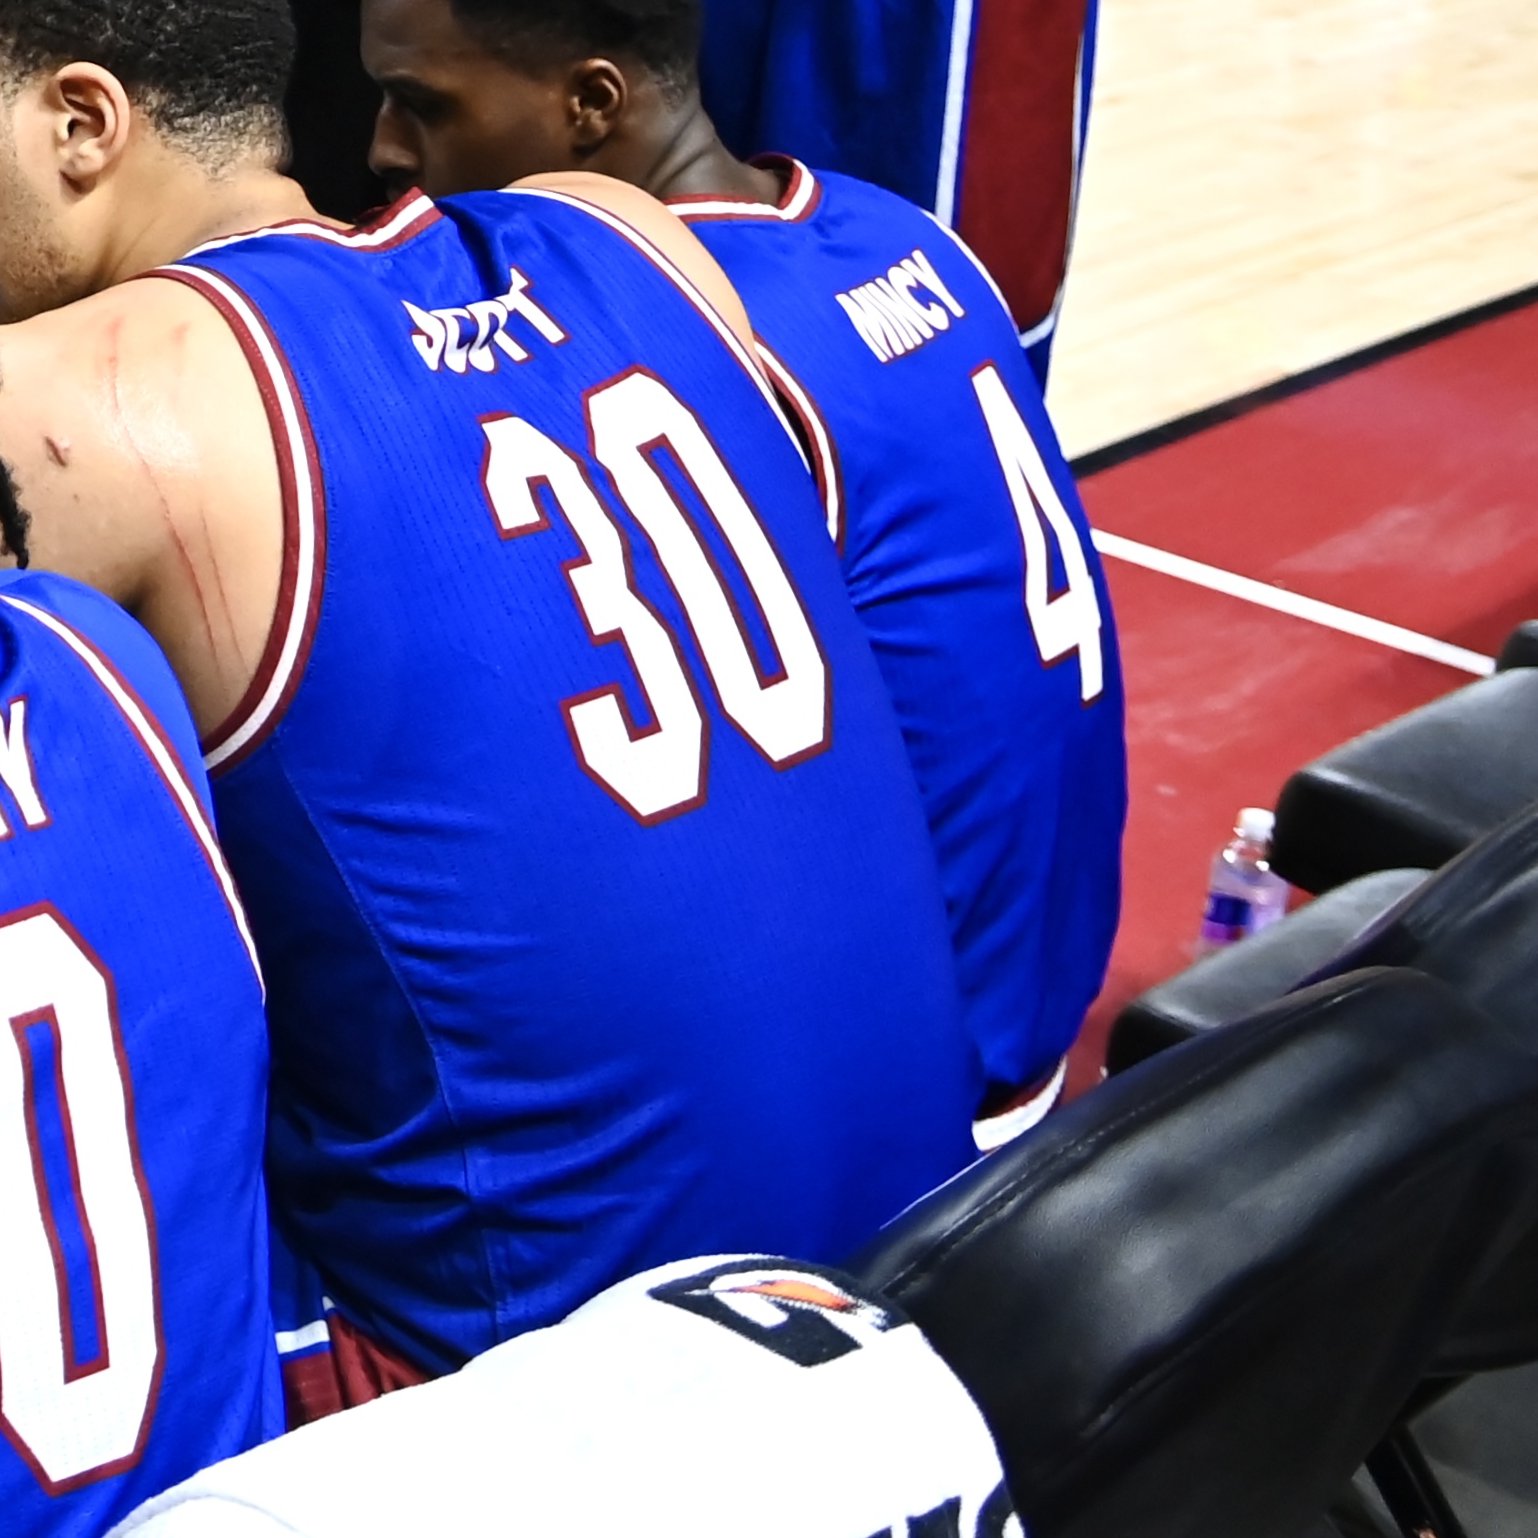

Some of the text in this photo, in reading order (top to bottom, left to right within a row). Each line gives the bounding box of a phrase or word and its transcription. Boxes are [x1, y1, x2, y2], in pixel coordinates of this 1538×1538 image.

[834, 247, 967, 364] MINCY
[478, 364, 832, 826] 30
[970, 359, 1104, 709] 4
